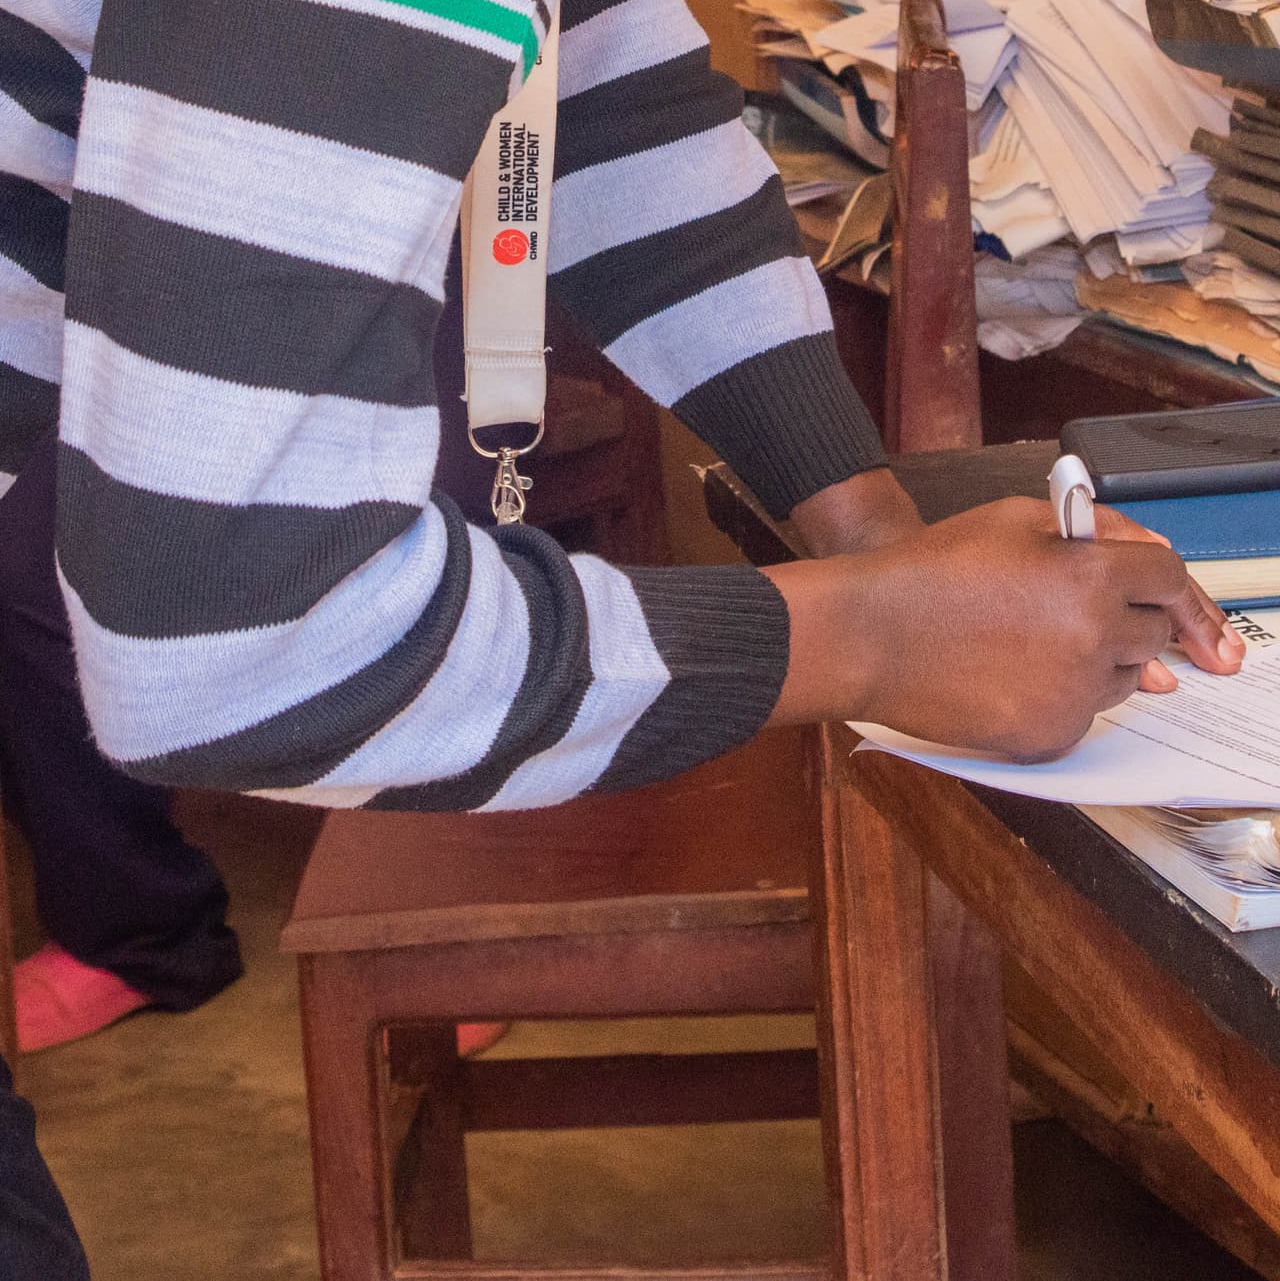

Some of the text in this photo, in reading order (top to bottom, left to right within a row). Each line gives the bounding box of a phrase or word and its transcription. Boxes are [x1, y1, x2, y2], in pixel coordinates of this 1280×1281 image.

[498, 122, 512, 222] CHILD & WOMEN
[511, 123, 526, 222] INTERNATIONAL
[526, 131, 540, 222] DEVELOPMENT
[530, 231, 538, 260] CHWID
